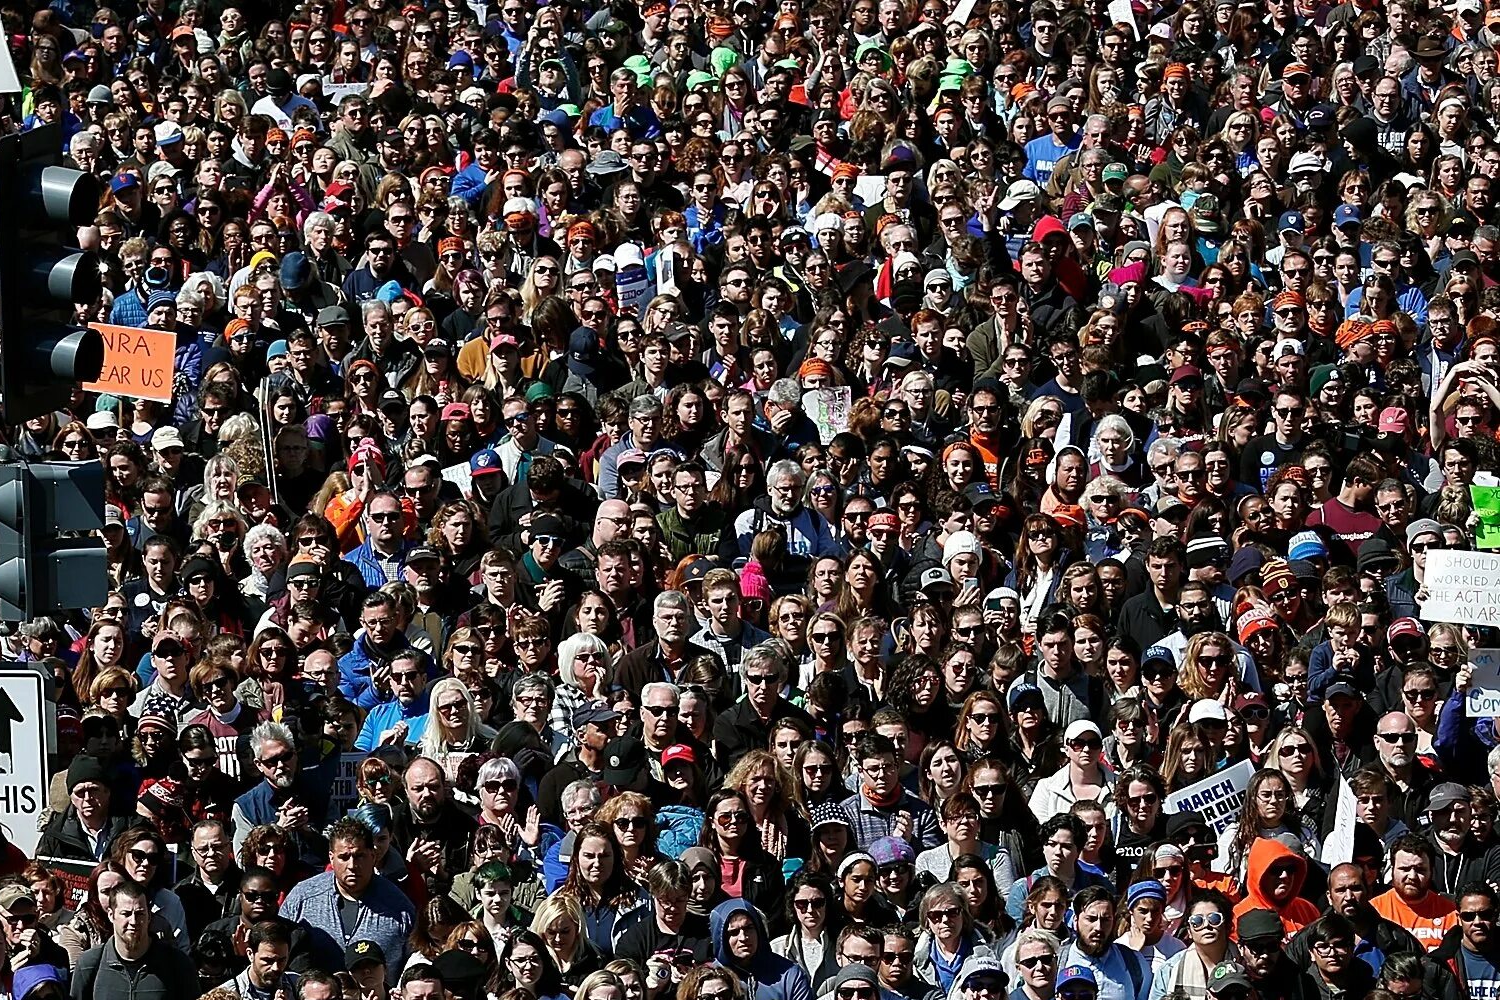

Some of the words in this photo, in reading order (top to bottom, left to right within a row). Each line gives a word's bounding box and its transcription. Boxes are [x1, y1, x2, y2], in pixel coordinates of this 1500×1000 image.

[98, 365, 131, 385] EAR
[141, 368, 164, 388] US
[1445, 558, 1499, 571] SHOULD
[1434, 576, 1489, 588] WORRIED
[1430, 590, 1450, 602] THE
[1454, 590, 1483, 604] ACT
[1455, 607, 1473, 620] AN
[1176, 778, 1236, 815] MARCH
[1216, 790, 1248, 817] OUR
